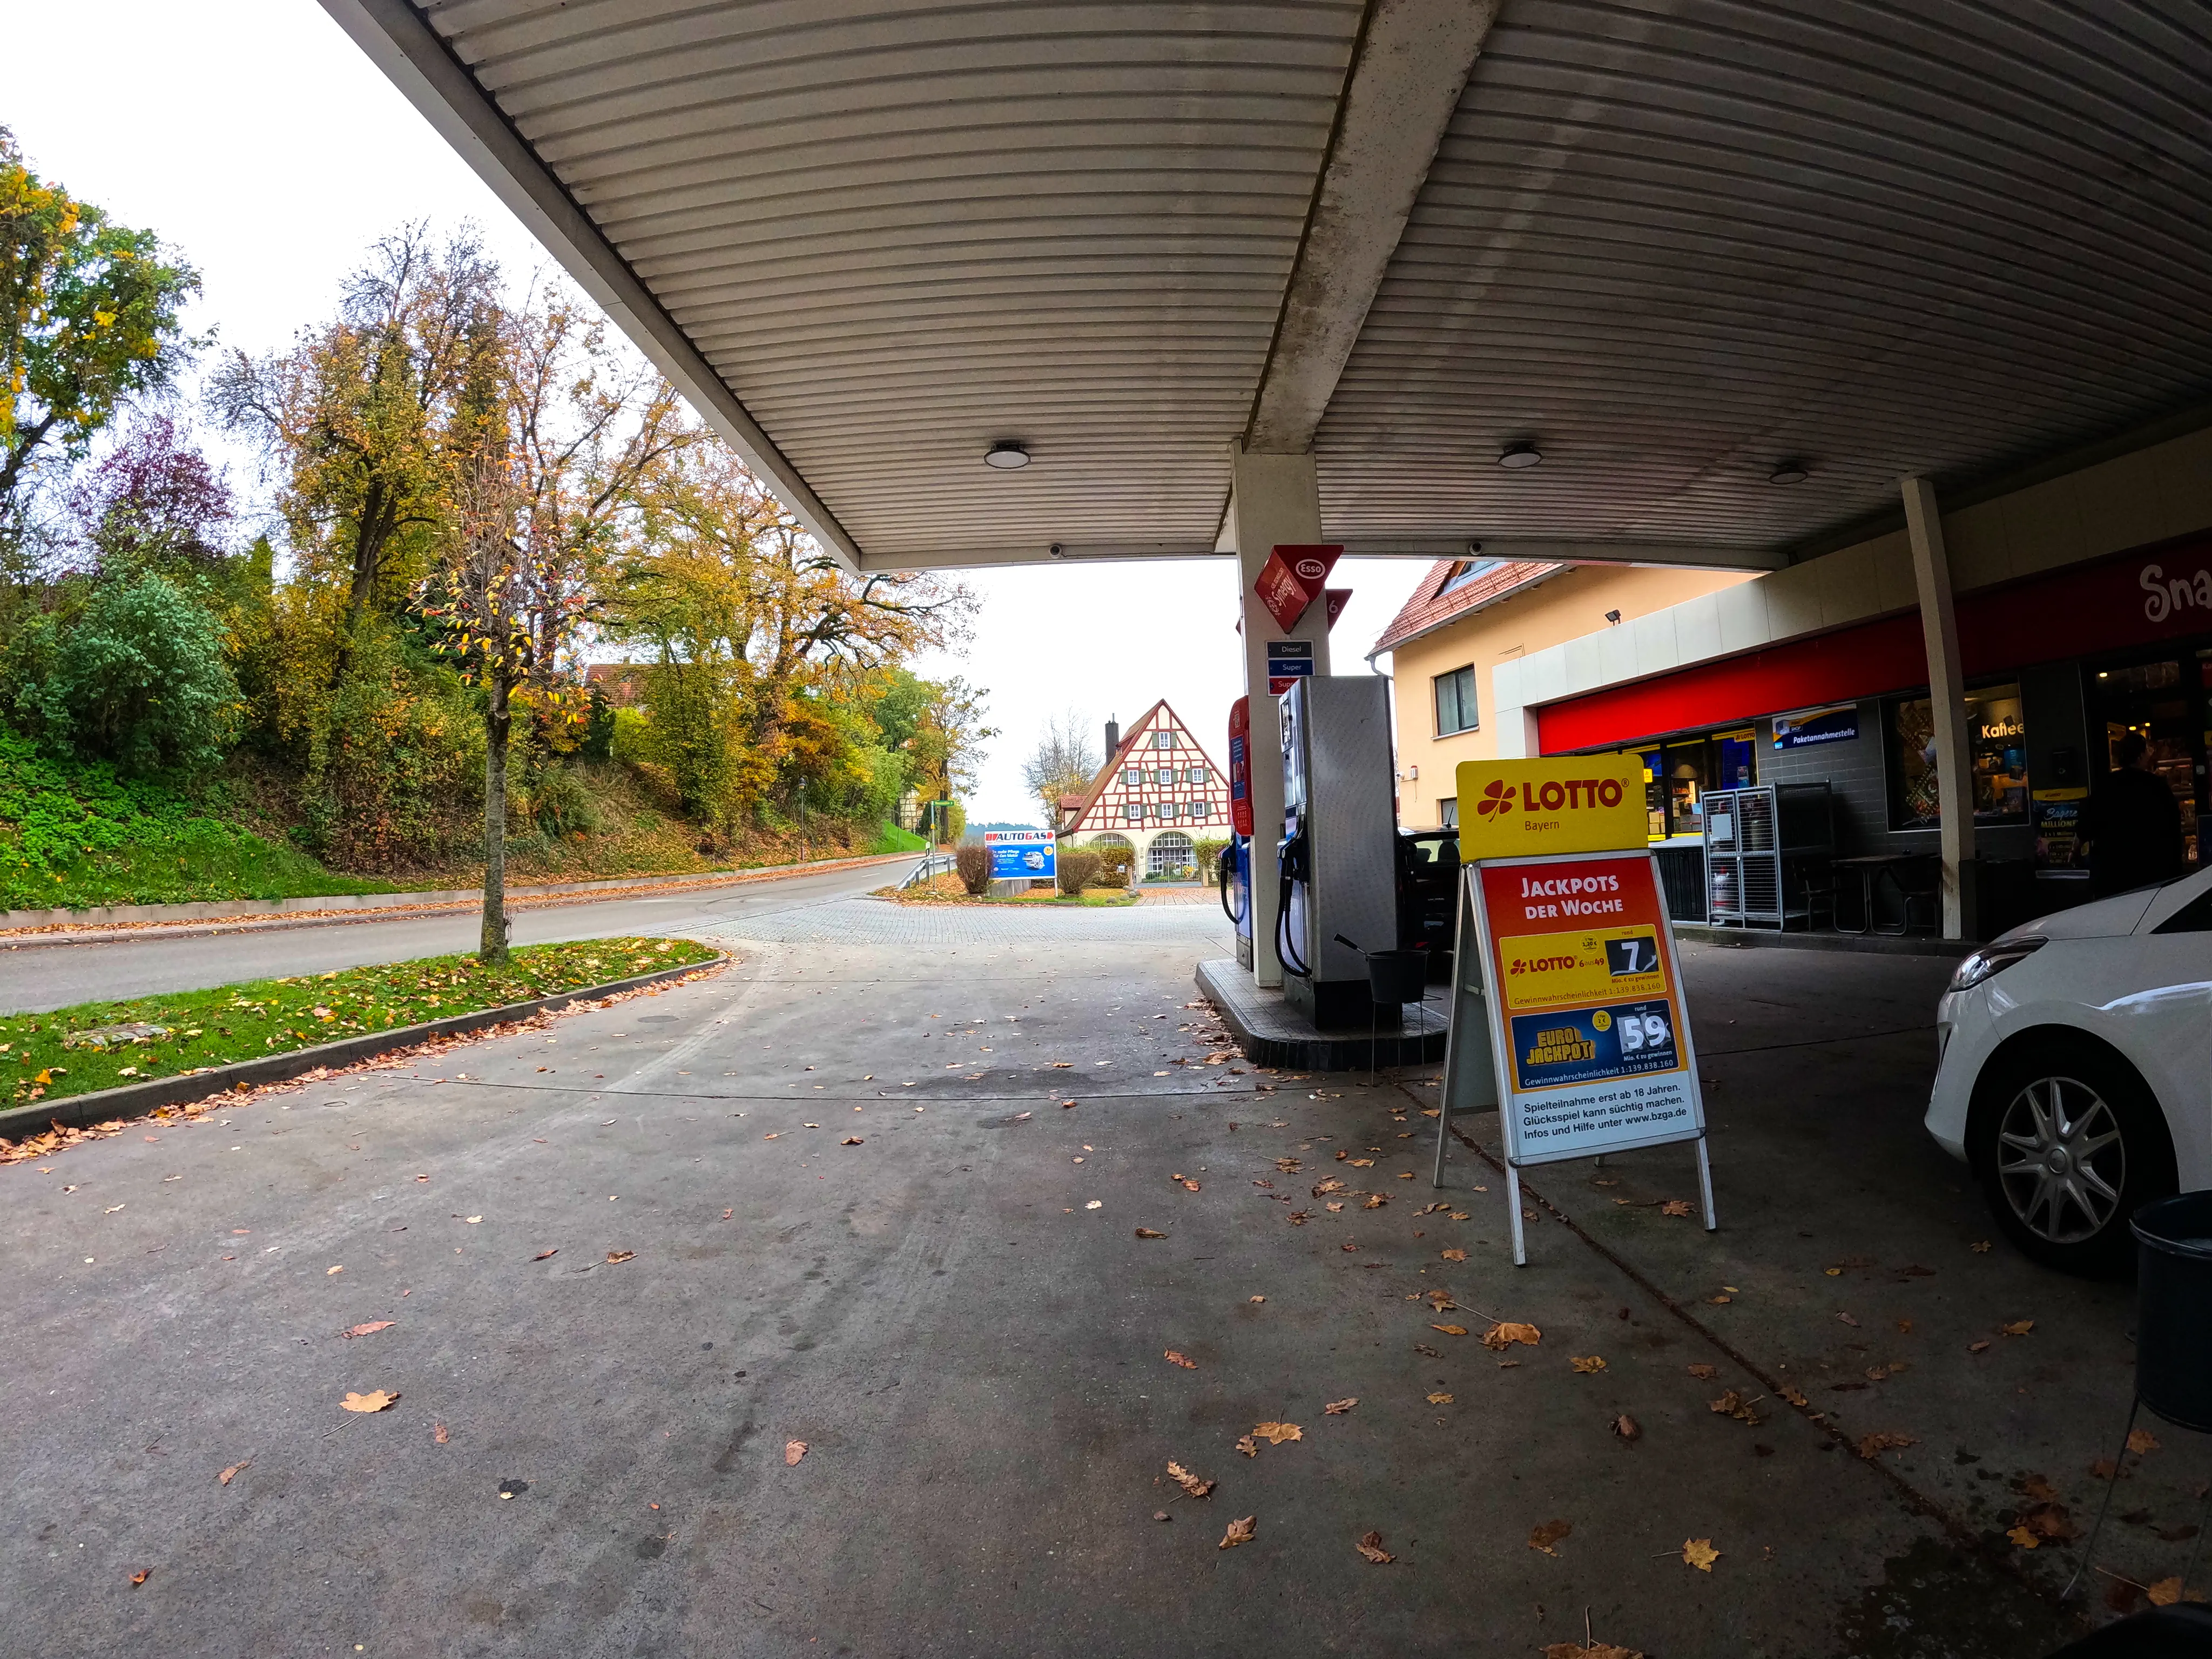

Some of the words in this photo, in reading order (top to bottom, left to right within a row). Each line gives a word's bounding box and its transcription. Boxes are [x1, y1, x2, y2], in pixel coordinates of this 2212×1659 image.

[1300, 563, 1321, 573] Esso
[1271, 574, 1296, 608] Synergy
[1328, 600, 1339, 613] 6
[1793, 728, 1855, 744] Paketannahmestelle
[1523, 778, 1622, 811] LOTTO
[996, 832, 1047, 841] AUTOGAS
[1525, 820, 1560, 832] Bayern
[1521, 875, 1620, 898] JACKPOTS
[1561, 899, 1623, 916] WOCHE
[1529, 956, 1575, 973] LOTTO
[1621, 941, 1639, 970] 7
[1514, 990, 1607, 1004] Gewinnwahrscheinlichkeit
[1609, 982, 1661, 995] 1:139.838.160
[1537, 1028, 1576, 1047] EURO
[1624, 1015, 1665, 1049] 59
[1526, 1041, 1592, 1065] JACKPOT
[1648, 1050, 1673, 1059] gewinnen
[1525, 1067, 1619, 1086] Gewinnwahrscheinlichkeit
[1621, 1060, 1674, 1073] 1:139.838.160
[1524, 1097, 1595, 1114] Spielteilnahme
[1599, 1092, 1617, 1104] erst
[1620, 1090, 1631, 1100] ab
[1634, 1089, 1644, 1097] 18
[1647, 1084, 1681, 1096] Jahren.
[1523, 1111, 1580, 1126] Glücksspiel
[1582, 1108, 1607, 1118] kann
[1609, 1102, 1643, 1115] süchtig
[1645, 1096, 1684, 1109] machen.
[1523, 1129, 1549, 1139] Infos
[1552, 1125, 1570, 1136] und
[1573, 1122, 1595, 1133] Hilfe
[1598, 1119, 1622, 1129] unter
[1625, 1108, 1687, 1125] www.bzga.de
